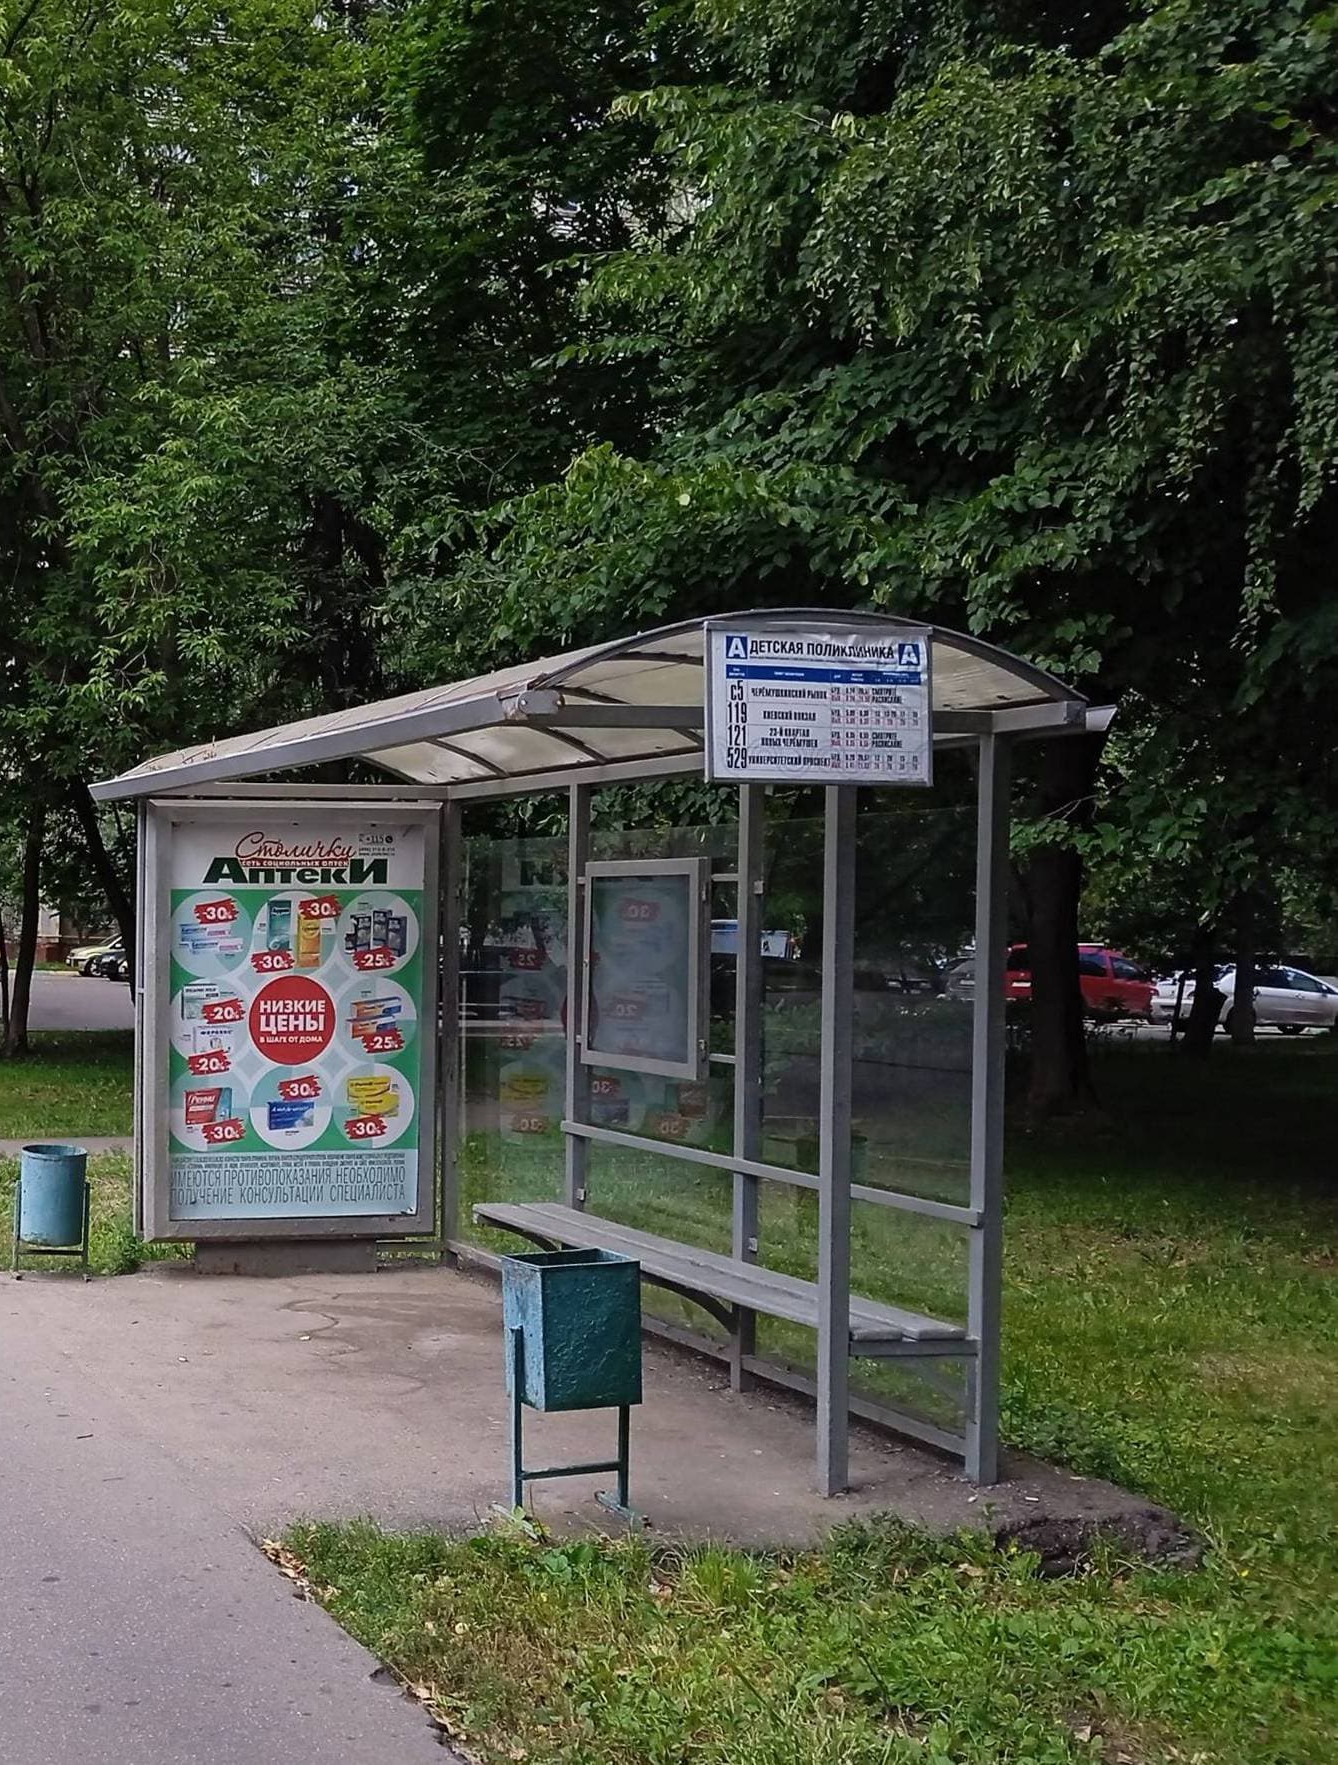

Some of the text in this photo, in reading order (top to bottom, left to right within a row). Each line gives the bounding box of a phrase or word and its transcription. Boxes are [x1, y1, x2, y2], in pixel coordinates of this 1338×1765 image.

[750, 639, 803, 655] ДЕТСКАЯ
[807, 642, 894, 659] ПОЛИКЛИНИКА
[728, 701, 747, 723] 119
[728, 724, 746, 746] 121
[727, 747, 747, 768] 529
[235, 831, 357, 858] Столички
[259, 1000, 326, 1013] НИЗКИЕ
[259, 1014, 325, 1035] ЦЕНЫ
[170, 1169, 220, 1188] ИМЕЮТСЯ
[336, 1166, 406, 1184] НЕОБХОДИМО
[170, 1183, 405, 1205] ПОЛУЧЕНИЕ КОНСУЛЬТАЦИИ СПЕЦИАЛИСТА
